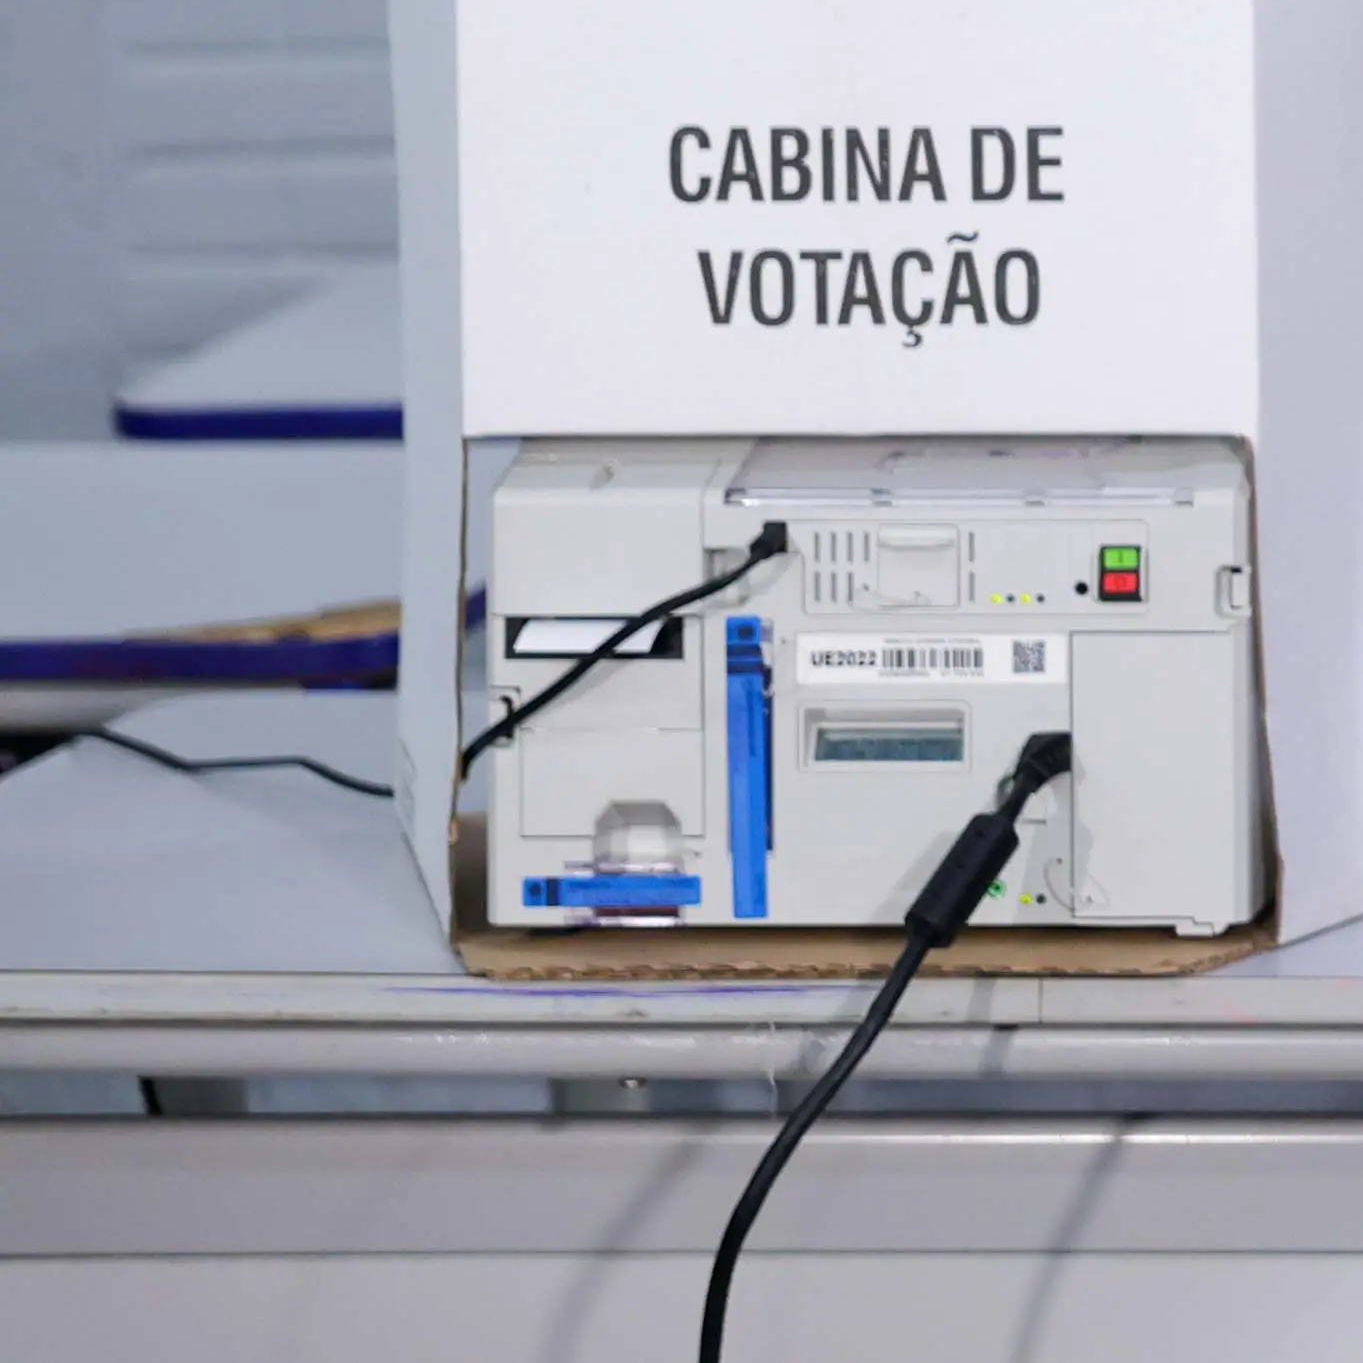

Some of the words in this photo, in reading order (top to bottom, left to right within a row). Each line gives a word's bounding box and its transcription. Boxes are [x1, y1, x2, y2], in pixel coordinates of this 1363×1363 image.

[669, 126, 947, 203] CABINA
[970, 127, 1065, 202] DE
[697, 232, 1041, 348] VOTAÇÃO
[811, 649, 877, 667] UE2022
